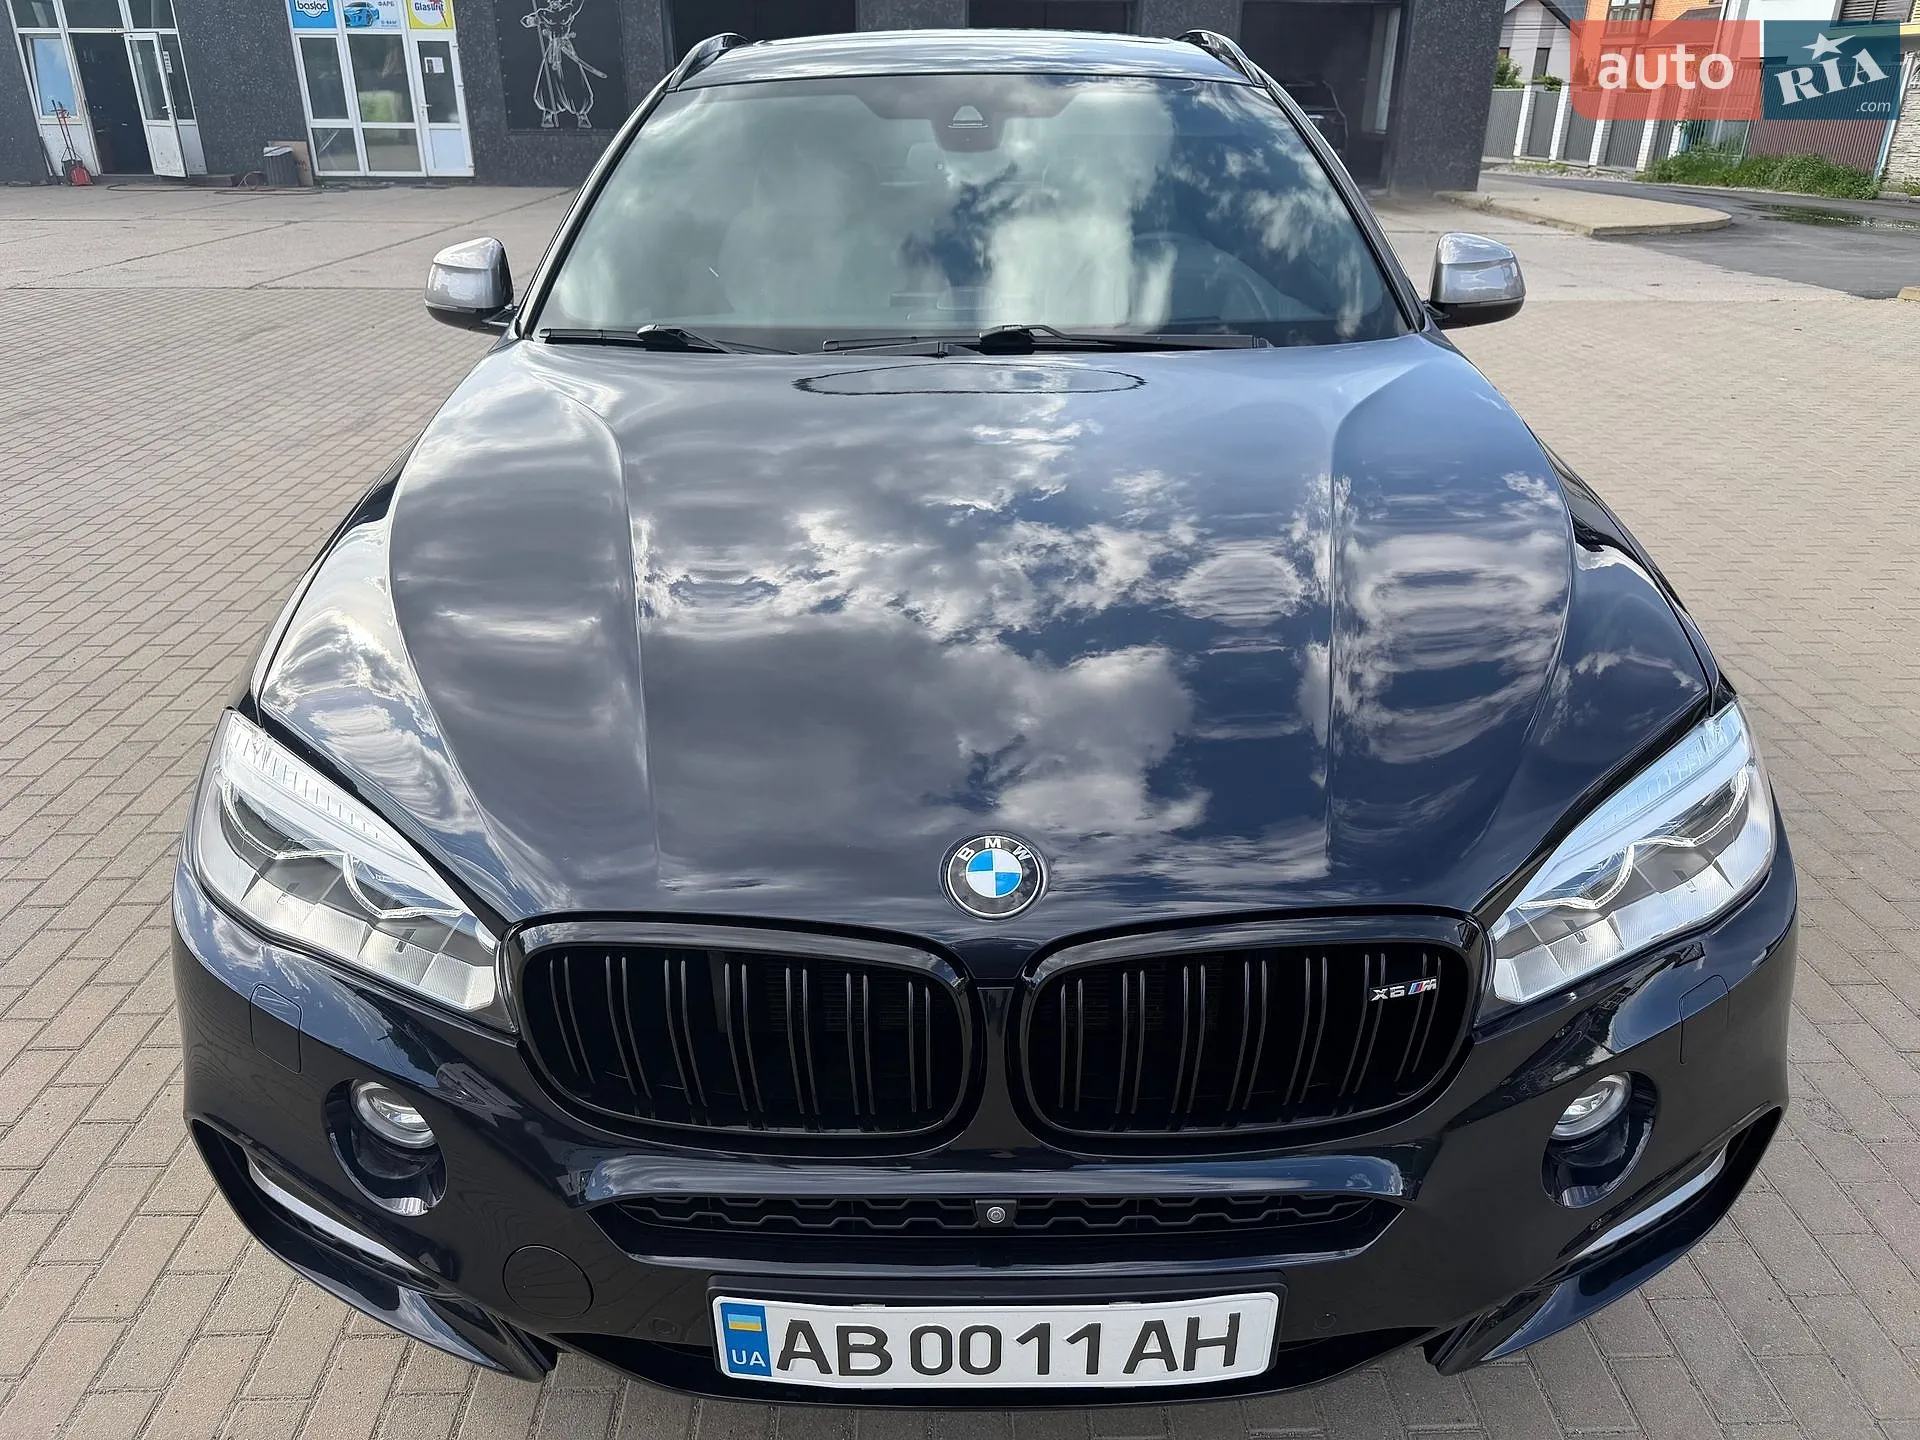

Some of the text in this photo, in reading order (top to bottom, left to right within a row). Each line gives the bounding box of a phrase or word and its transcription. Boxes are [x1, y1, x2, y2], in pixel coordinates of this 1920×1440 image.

[297, 1, 327, 10] baslac
[957, 837, 1031, 861] BMW
[731, 1350, 766, 1367] UA
